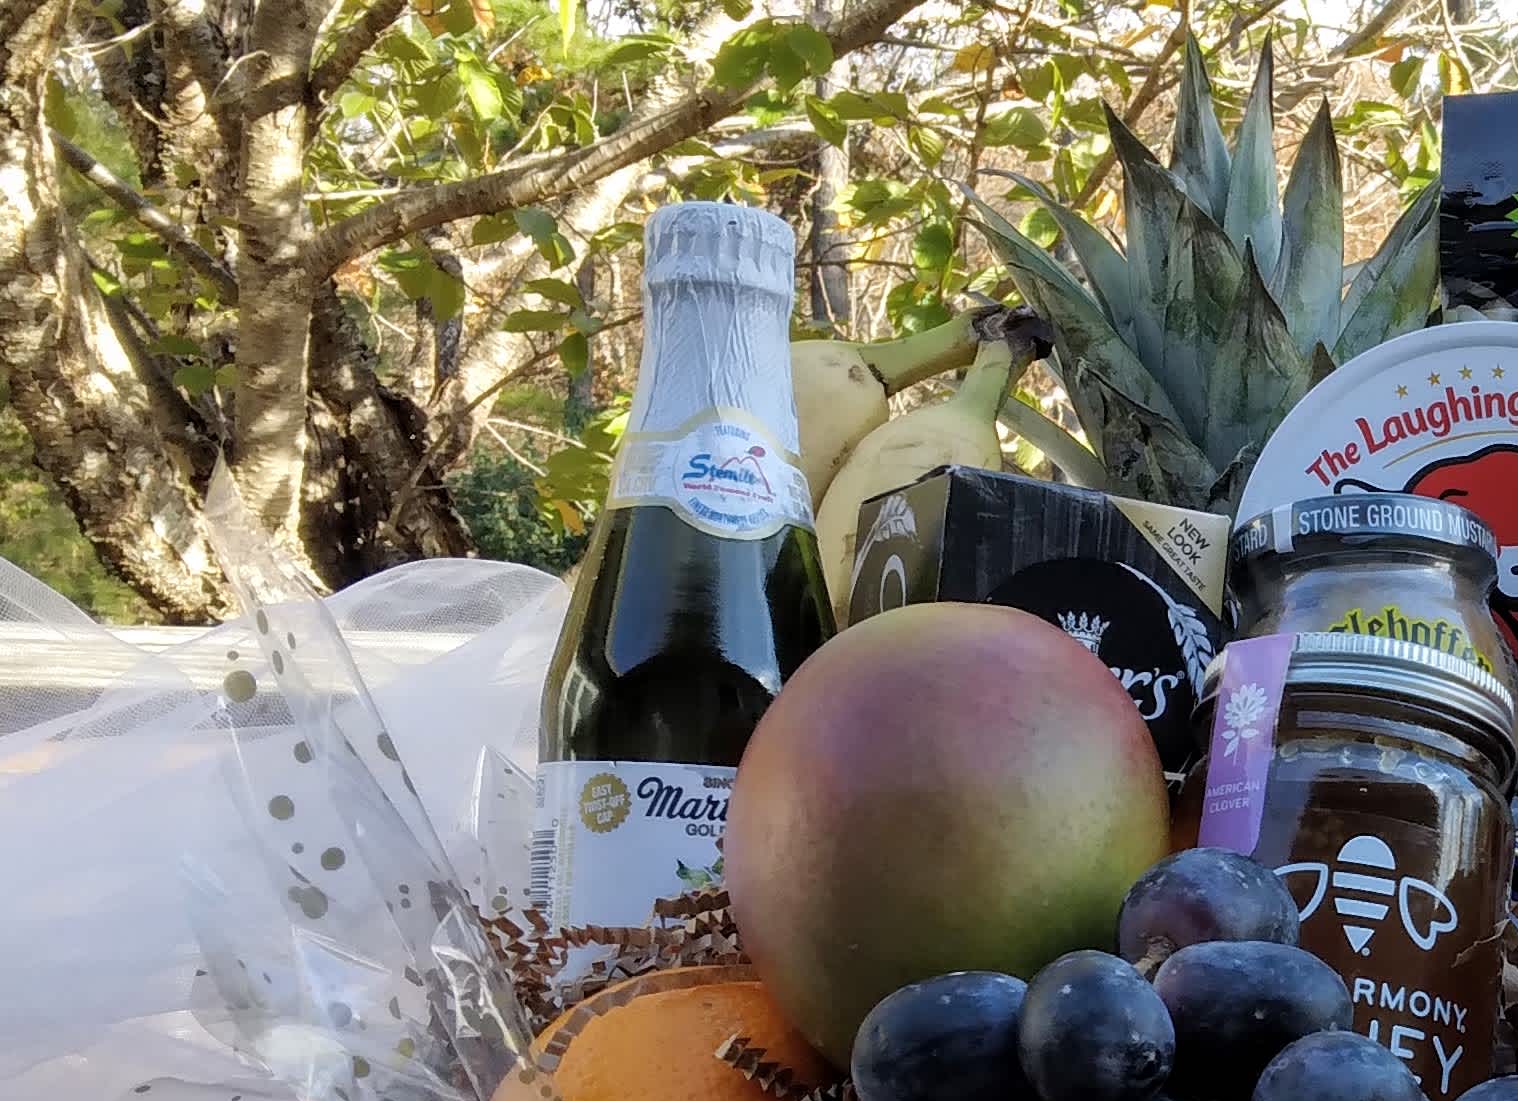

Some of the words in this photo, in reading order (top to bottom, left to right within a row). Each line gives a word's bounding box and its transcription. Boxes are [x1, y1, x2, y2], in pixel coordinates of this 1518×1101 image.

[1305, 442, 1362, 487] The
[1179, 518, 1211, 550] NEW
[1299, 505, 1361, 535] STONE
[1366, 506, 1444, 533] GROUND
[1143, 520, 1165, 545] SAME
[1162, 542, 1186, 568] GREAT
[1184, 566, 1206, 592] TASTE
[1167, 526, 1201, 565] LOOK
[1208, 781, 1260, 797] AMERICAN
[1210, 797, 1249, 814] CLOVER
